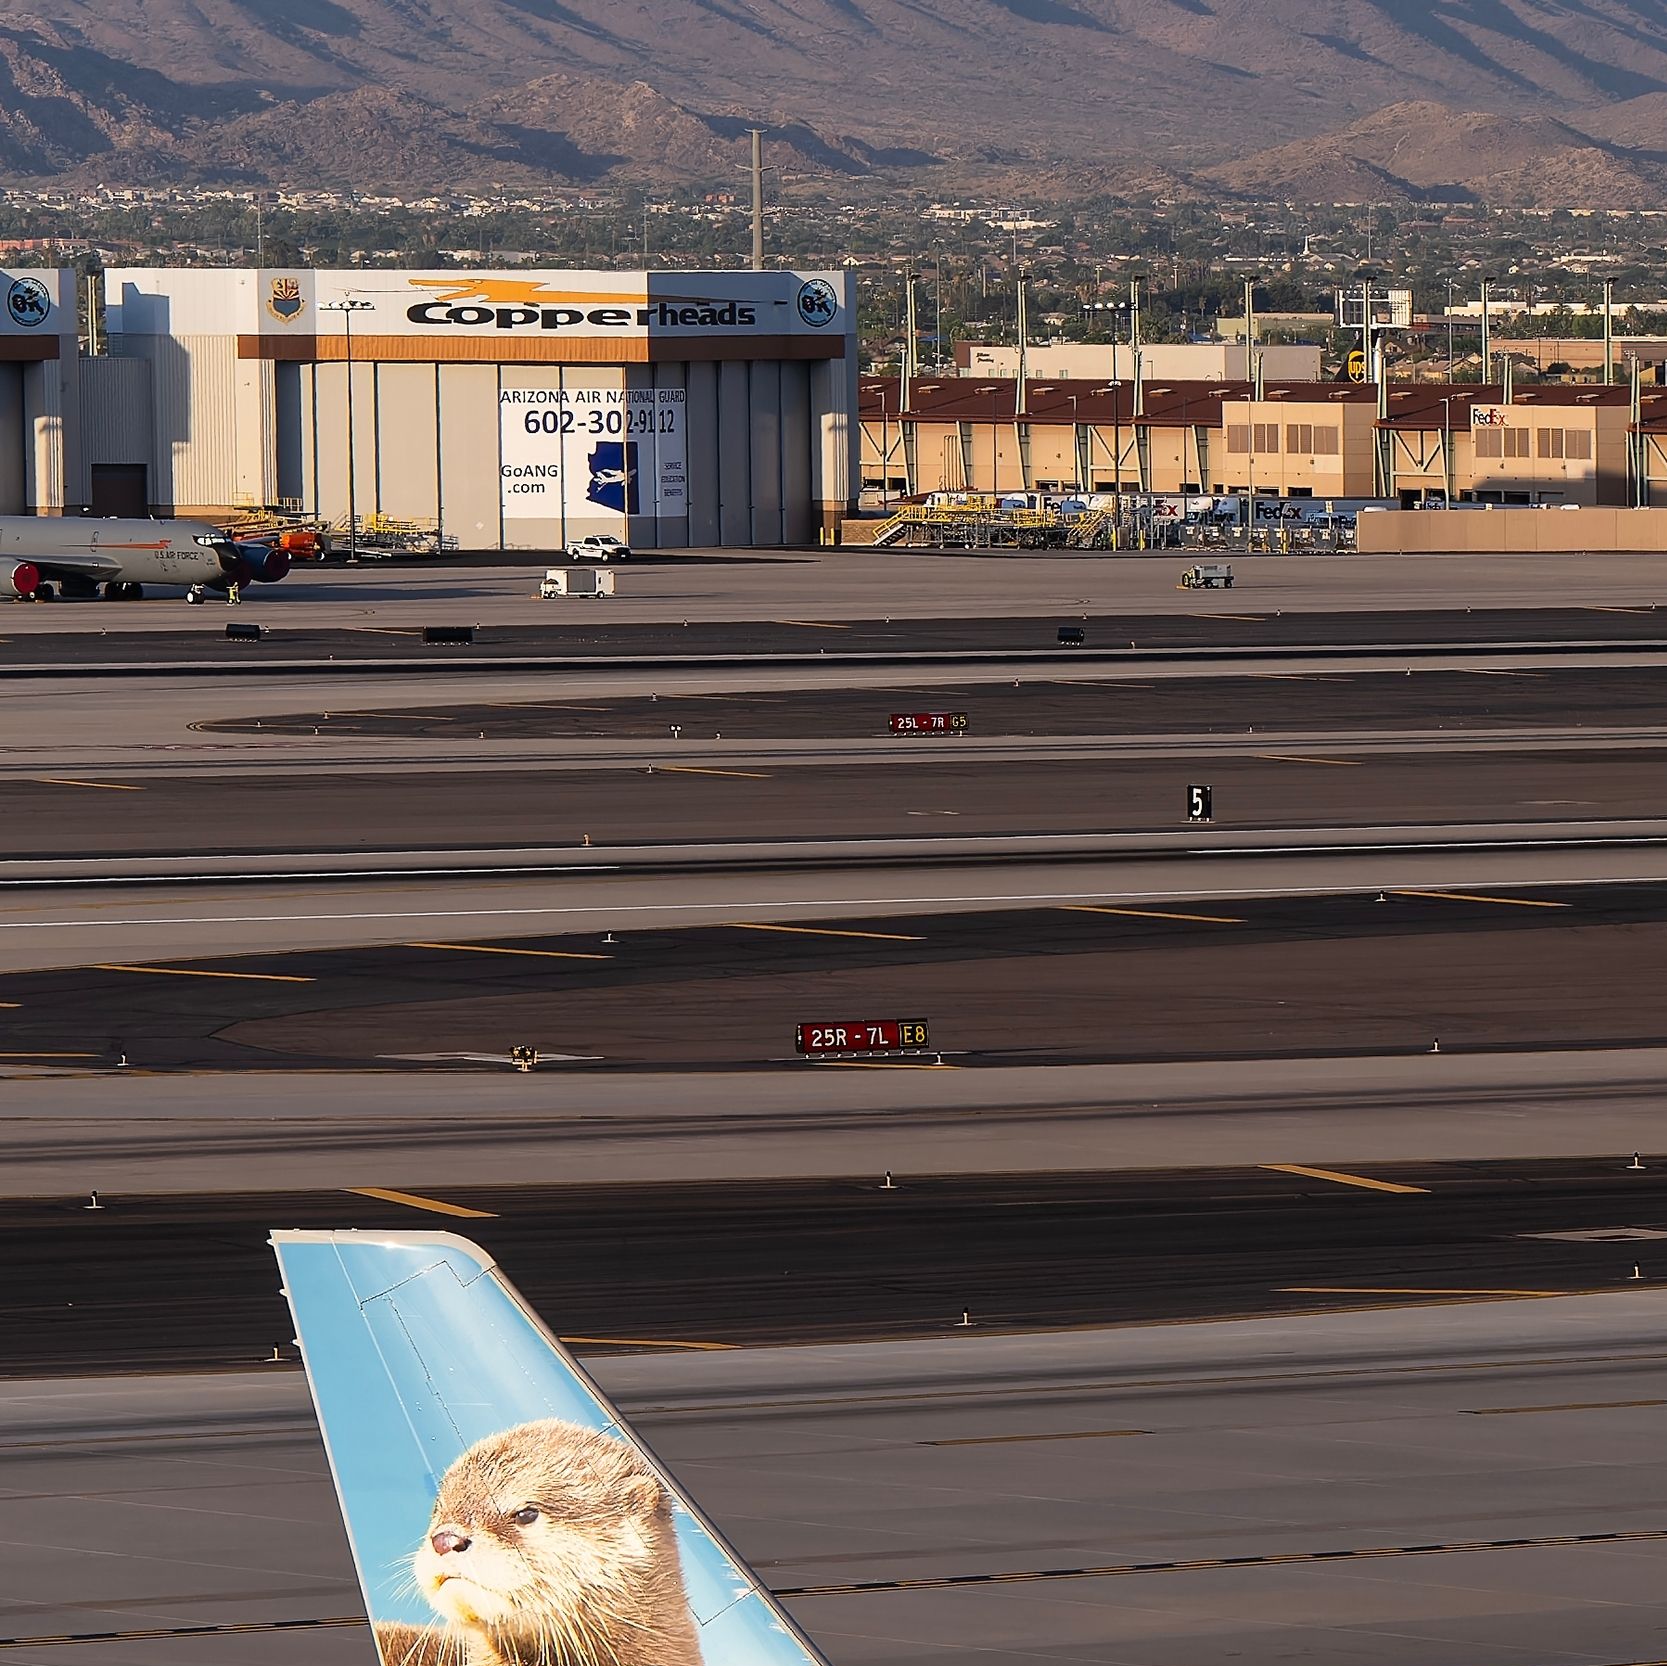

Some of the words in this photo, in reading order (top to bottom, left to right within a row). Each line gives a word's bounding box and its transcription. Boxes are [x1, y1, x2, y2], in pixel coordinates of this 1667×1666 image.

[407, 300, 756, 329] Copperheads
[500, 391, 570, 403] ARIZONA
[575, 391, 600, 403] AIR
[602, 391, 653, 403] NATIONAL
[659, 391, 685, 403] GUARD
[525, 410, 674, 434] 602-302-9112
[1473, 408, 1507, 425] FedEx
[501, 464, 558, 477] GoANG
[507, 483, 545, 493] .com
[897, 717, 919, 729] 25L
[930, 716, 944, 728] 7R
[952, 716, 966, 727] G5
[1192, 787, 1202, 816] 5
[811, 1028, 847, 1047] 25R
[866, 1026, 889, 1045] 7L
[903, 1025, 925, 1043] E8
